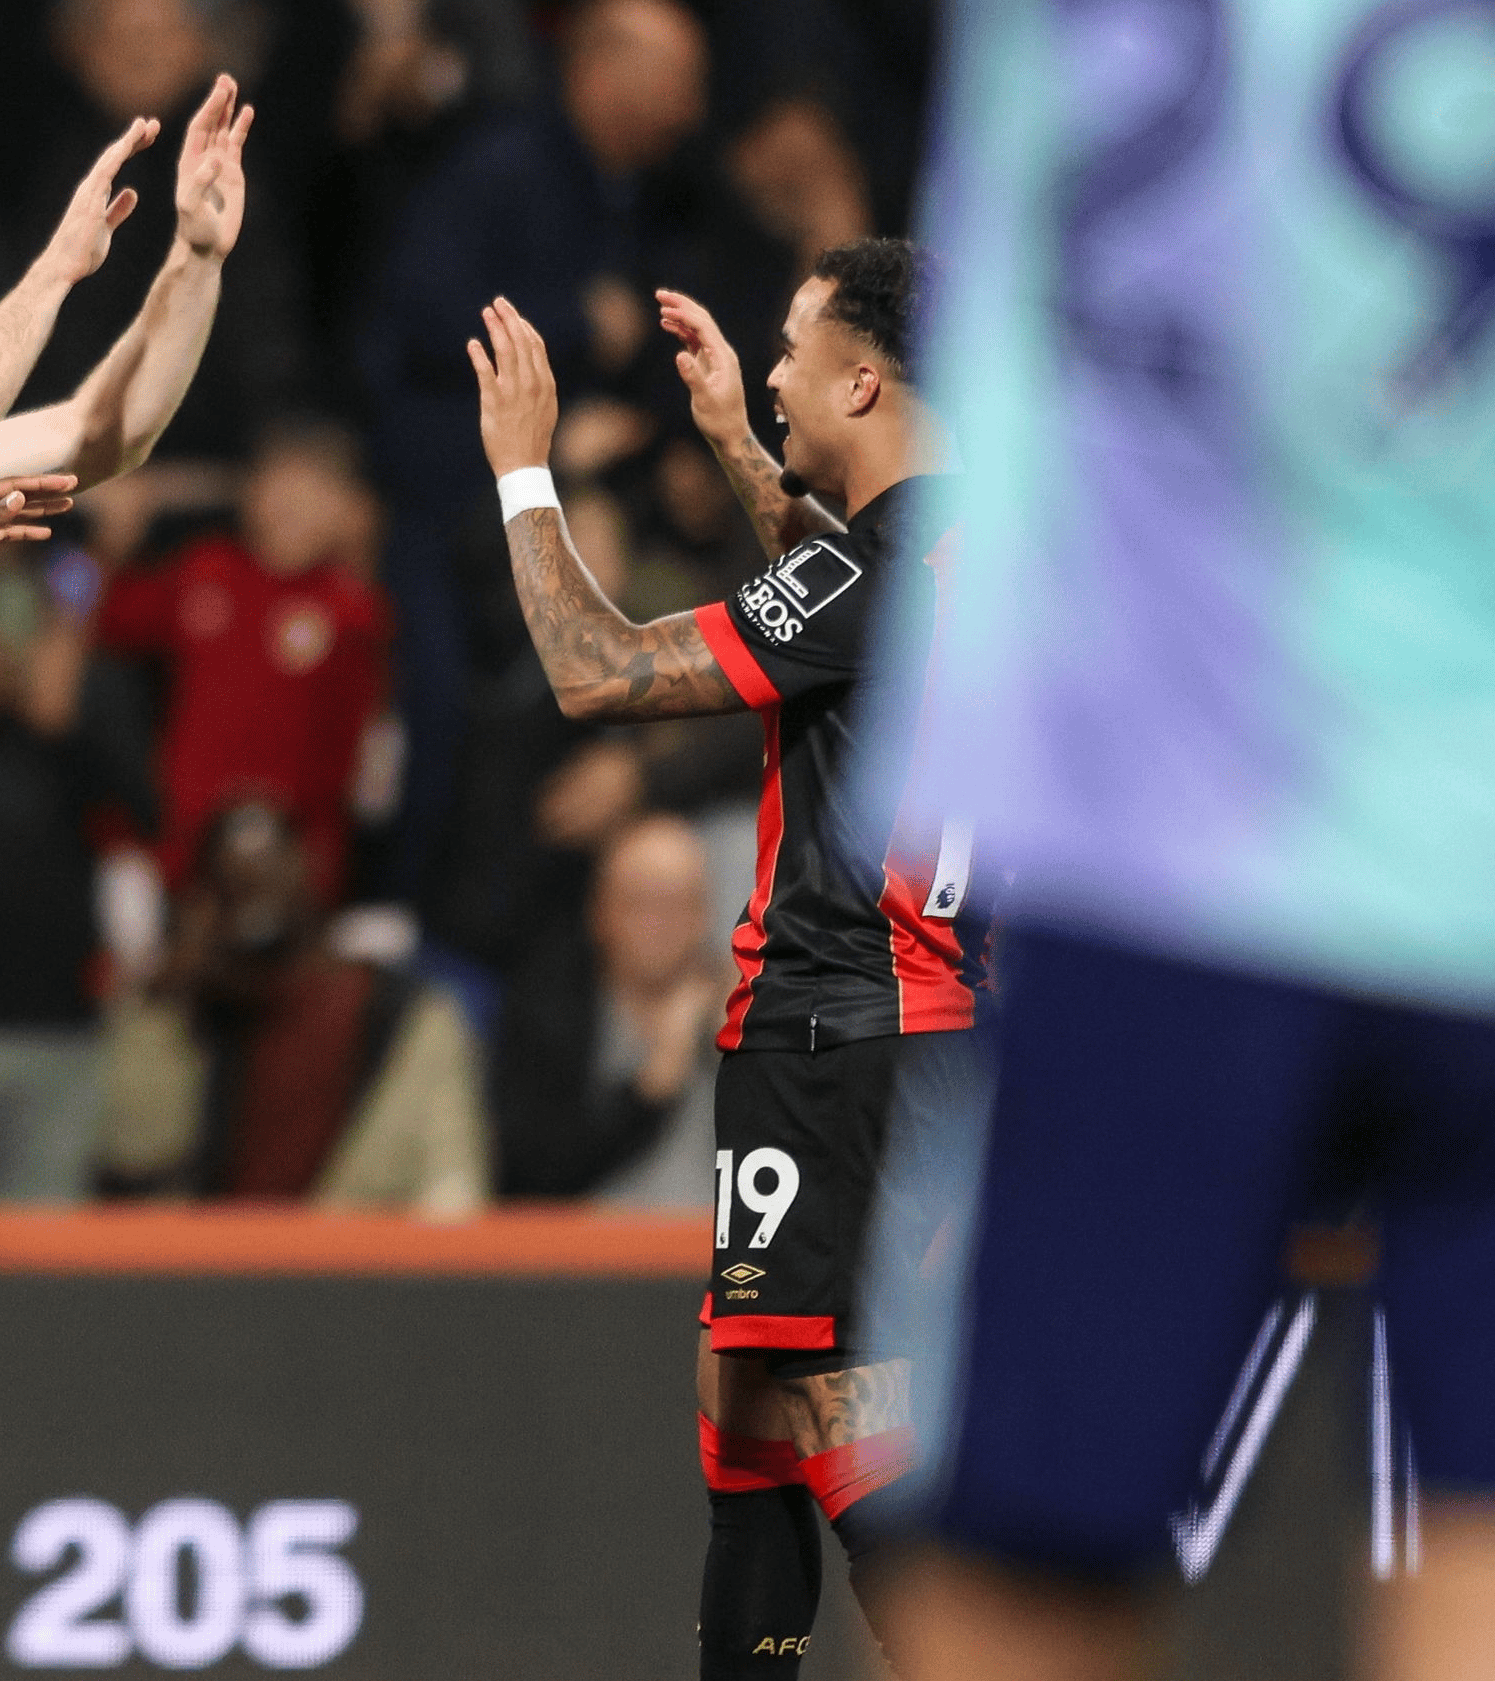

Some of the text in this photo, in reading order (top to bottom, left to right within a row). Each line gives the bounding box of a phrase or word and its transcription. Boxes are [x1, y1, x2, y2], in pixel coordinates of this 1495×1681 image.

[715, 1147, 800, 1249] 19
[725, 1289, 759, 1300] umbro
[6, 1496, 367, 1670] 205
[752, 1635, 812, 1656] AFC
